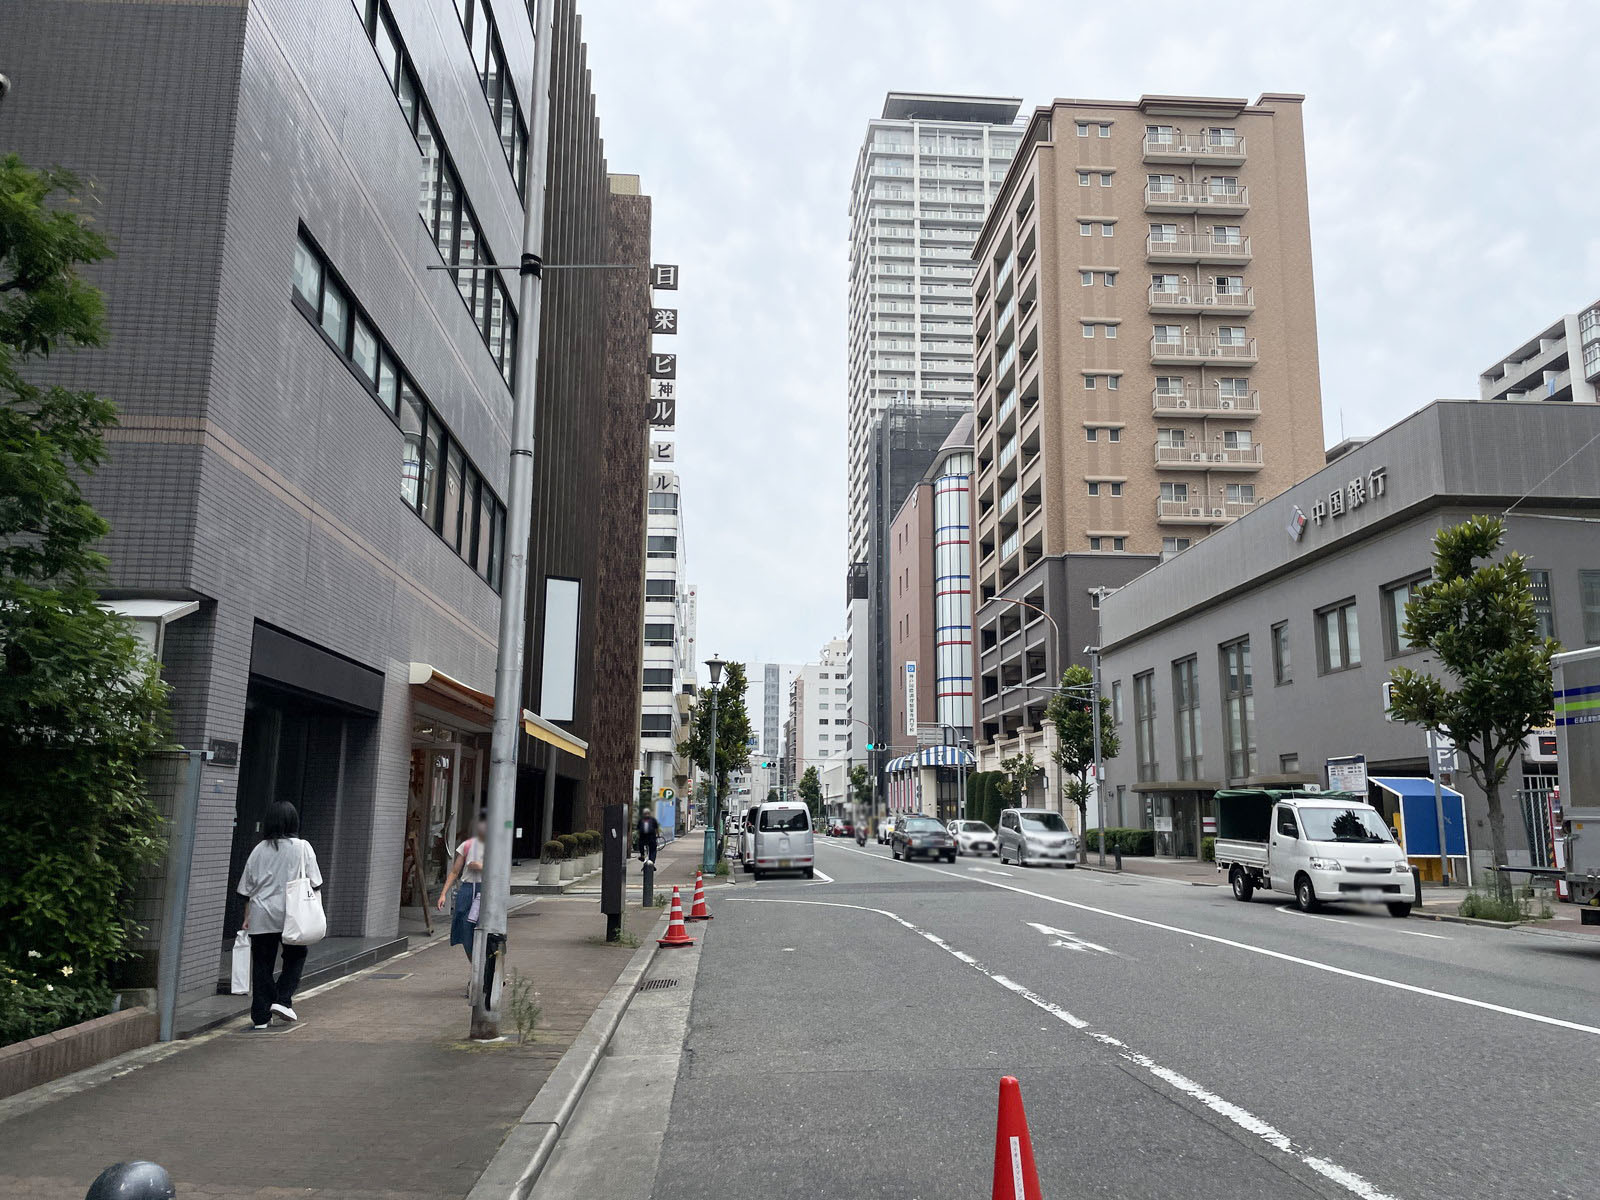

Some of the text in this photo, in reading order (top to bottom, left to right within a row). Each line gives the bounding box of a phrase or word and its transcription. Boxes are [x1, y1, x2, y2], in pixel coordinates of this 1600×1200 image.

[652, 265, 675, 421] 日栄ビル
[655, 381, 674, 490] 神ビル
[1311, 465, 1387, 526] 中国銀行
